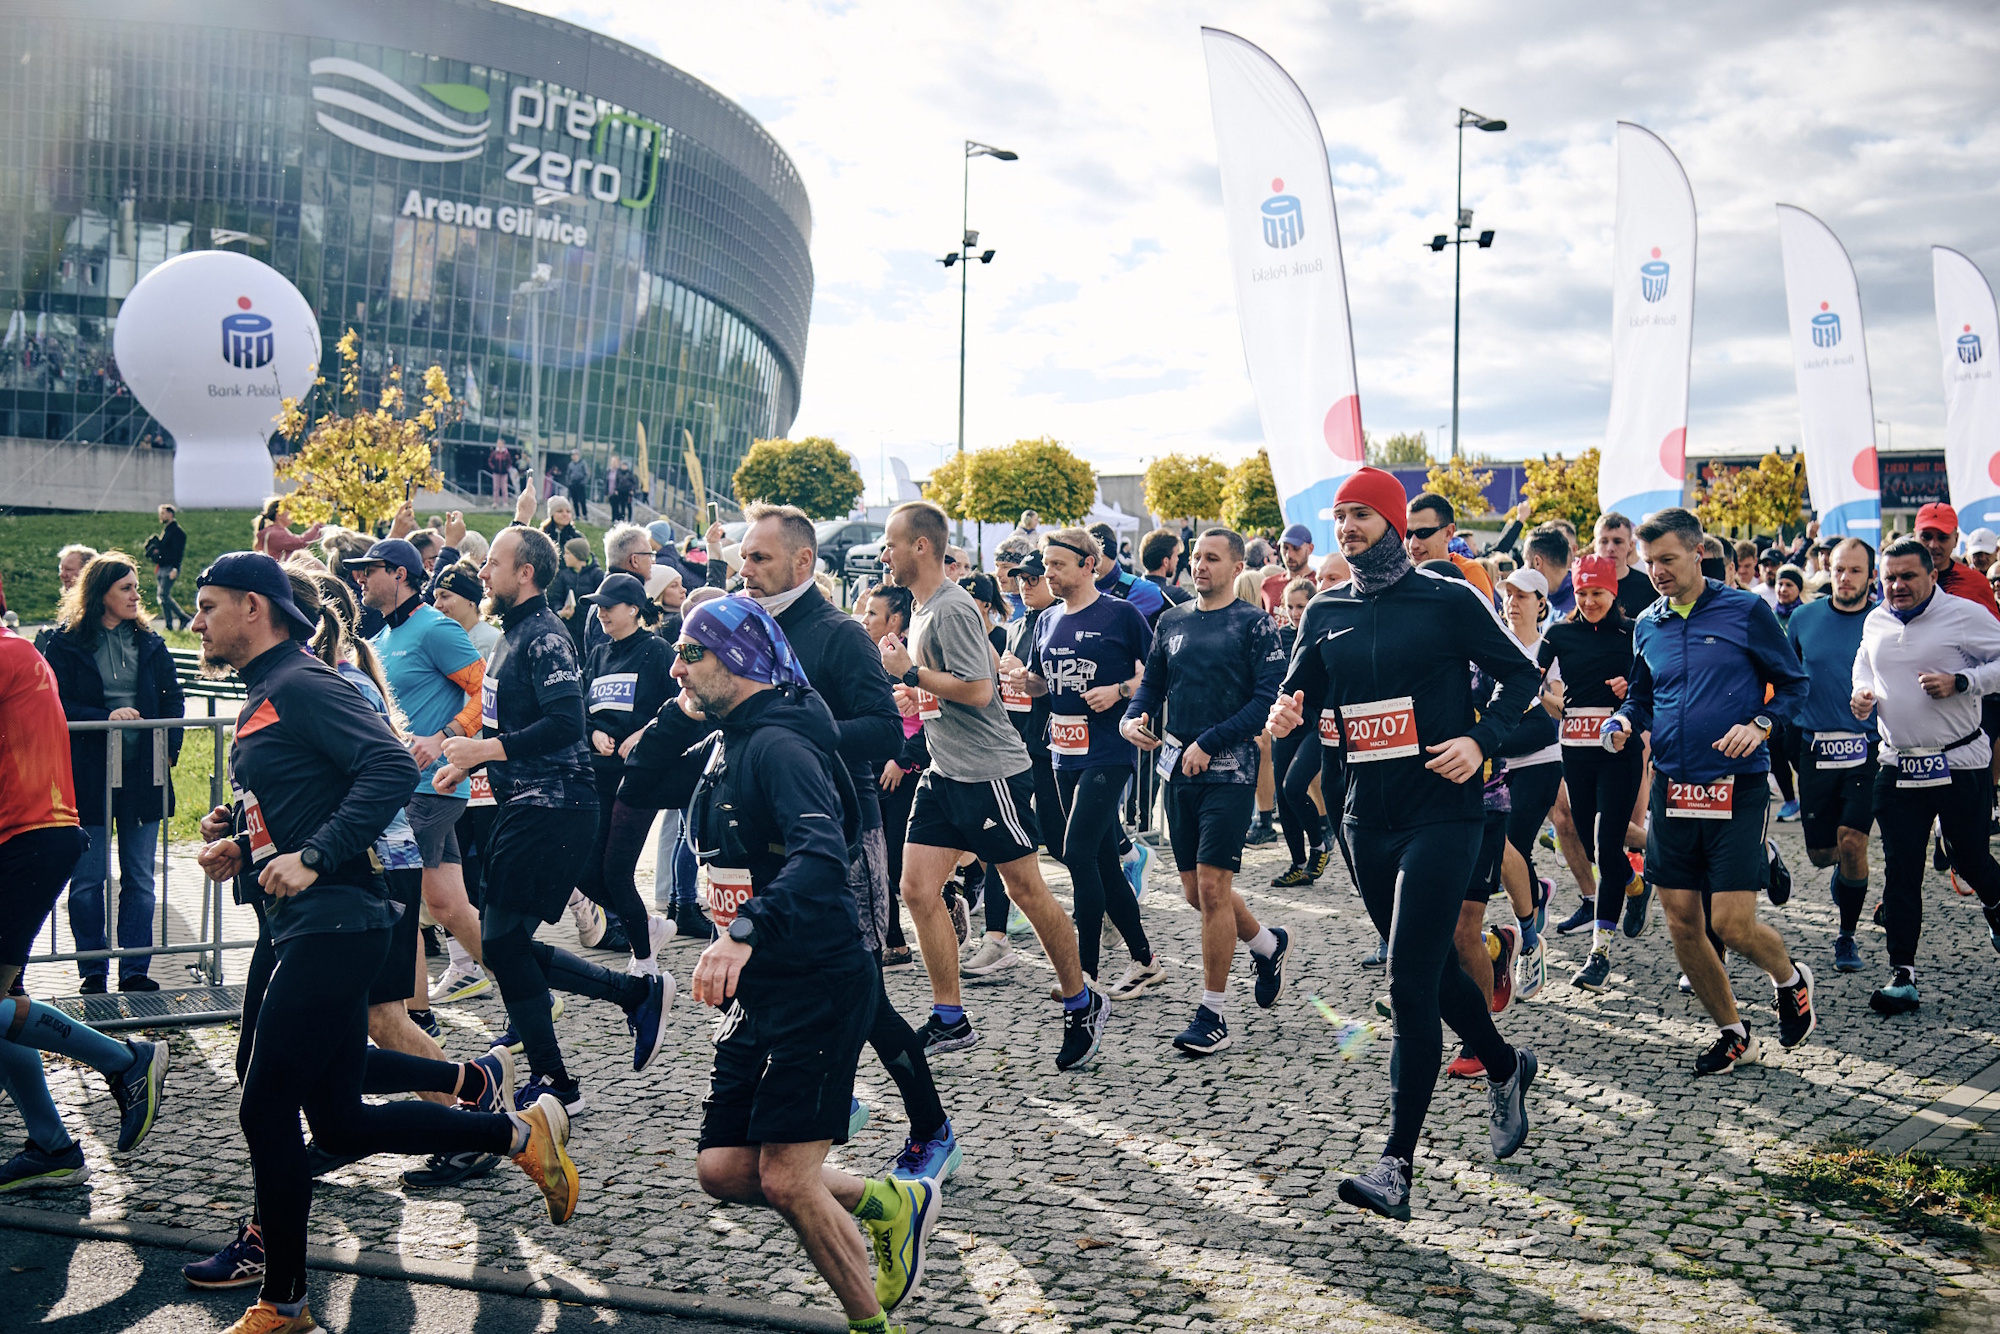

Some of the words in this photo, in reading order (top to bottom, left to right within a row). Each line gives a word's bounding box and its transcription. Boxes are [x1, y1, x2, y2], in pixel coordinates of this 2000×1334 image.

[509, 86, 597, 141] pre
[505, 142, 621, 203] zero
[402, 189, 492, 229] Arena
[496, 206, 588, 247] Gliwice
[207, 384, 242, 397] Bank
[592, 683, 631, 699] 10521
[1348, 713, 1409, 741] 20707
[1566, 718, 1600, 732] 2017
[1820, 740, 1864, 755] 10086
[1900, 756, 1945, 773] 10193
[1671, 783, 1728, 802] 21046
